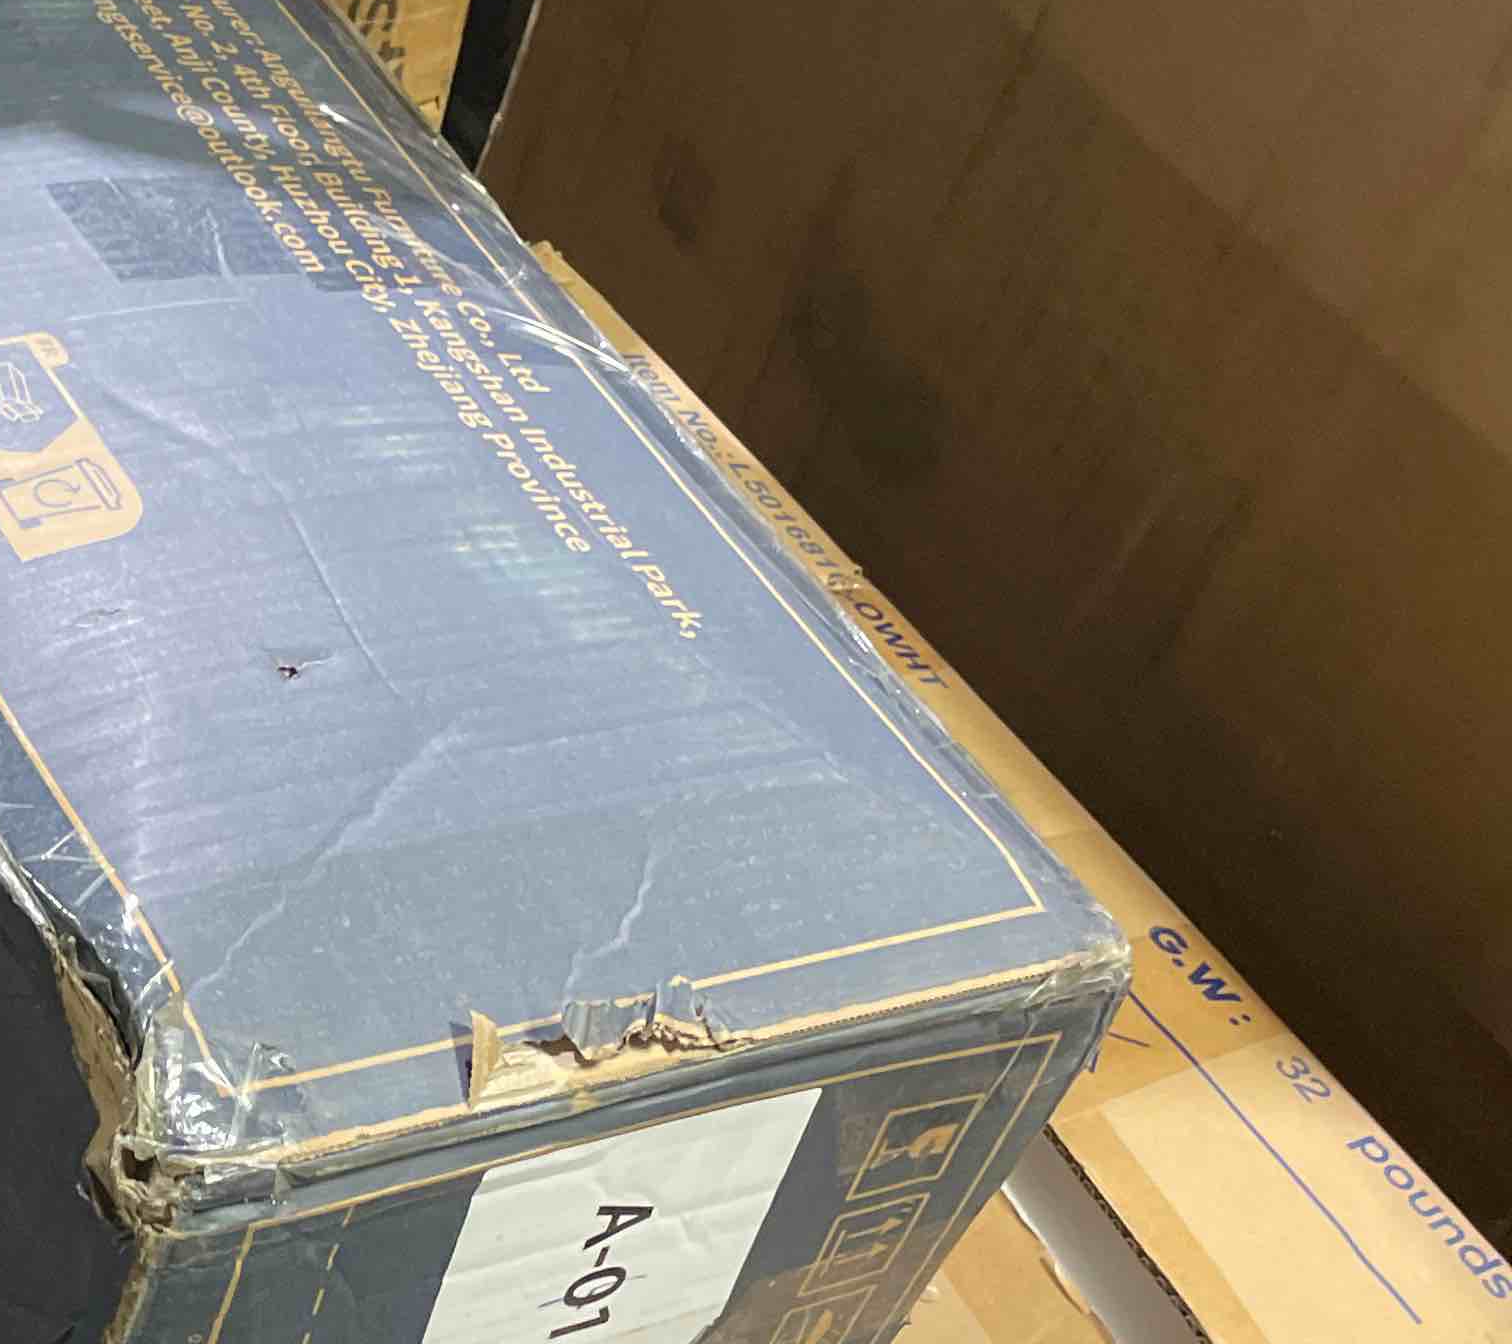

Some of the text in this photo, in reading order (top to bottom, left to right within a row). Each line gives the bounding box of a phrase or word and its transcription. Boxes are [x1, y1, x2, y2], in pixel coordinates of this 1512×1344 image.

[162, 32, 218, 74] Anji
[200, 76, 277, 161] County,
[268, 163, 354, 256] Huzhou
[344, 259, 398, 314] City,
[389, 317, 494, 430] Zhejiang
[481, 431, 592, 554] Province
[233, 64, 272, 99] 4th
[311, 170, 405, 271] Building
[414, 299, 530, 423] Kangshan
[519, 427, 649, 560] Industrial
[631, 563, 704, 640] Park,
[363, 185, 464, 297] Furniture
[497, 351, 552, 394] Ltd
[548, 1206, 654, 1340] A-01
[1274, 1055, 1512, 1299] 32 pounds
